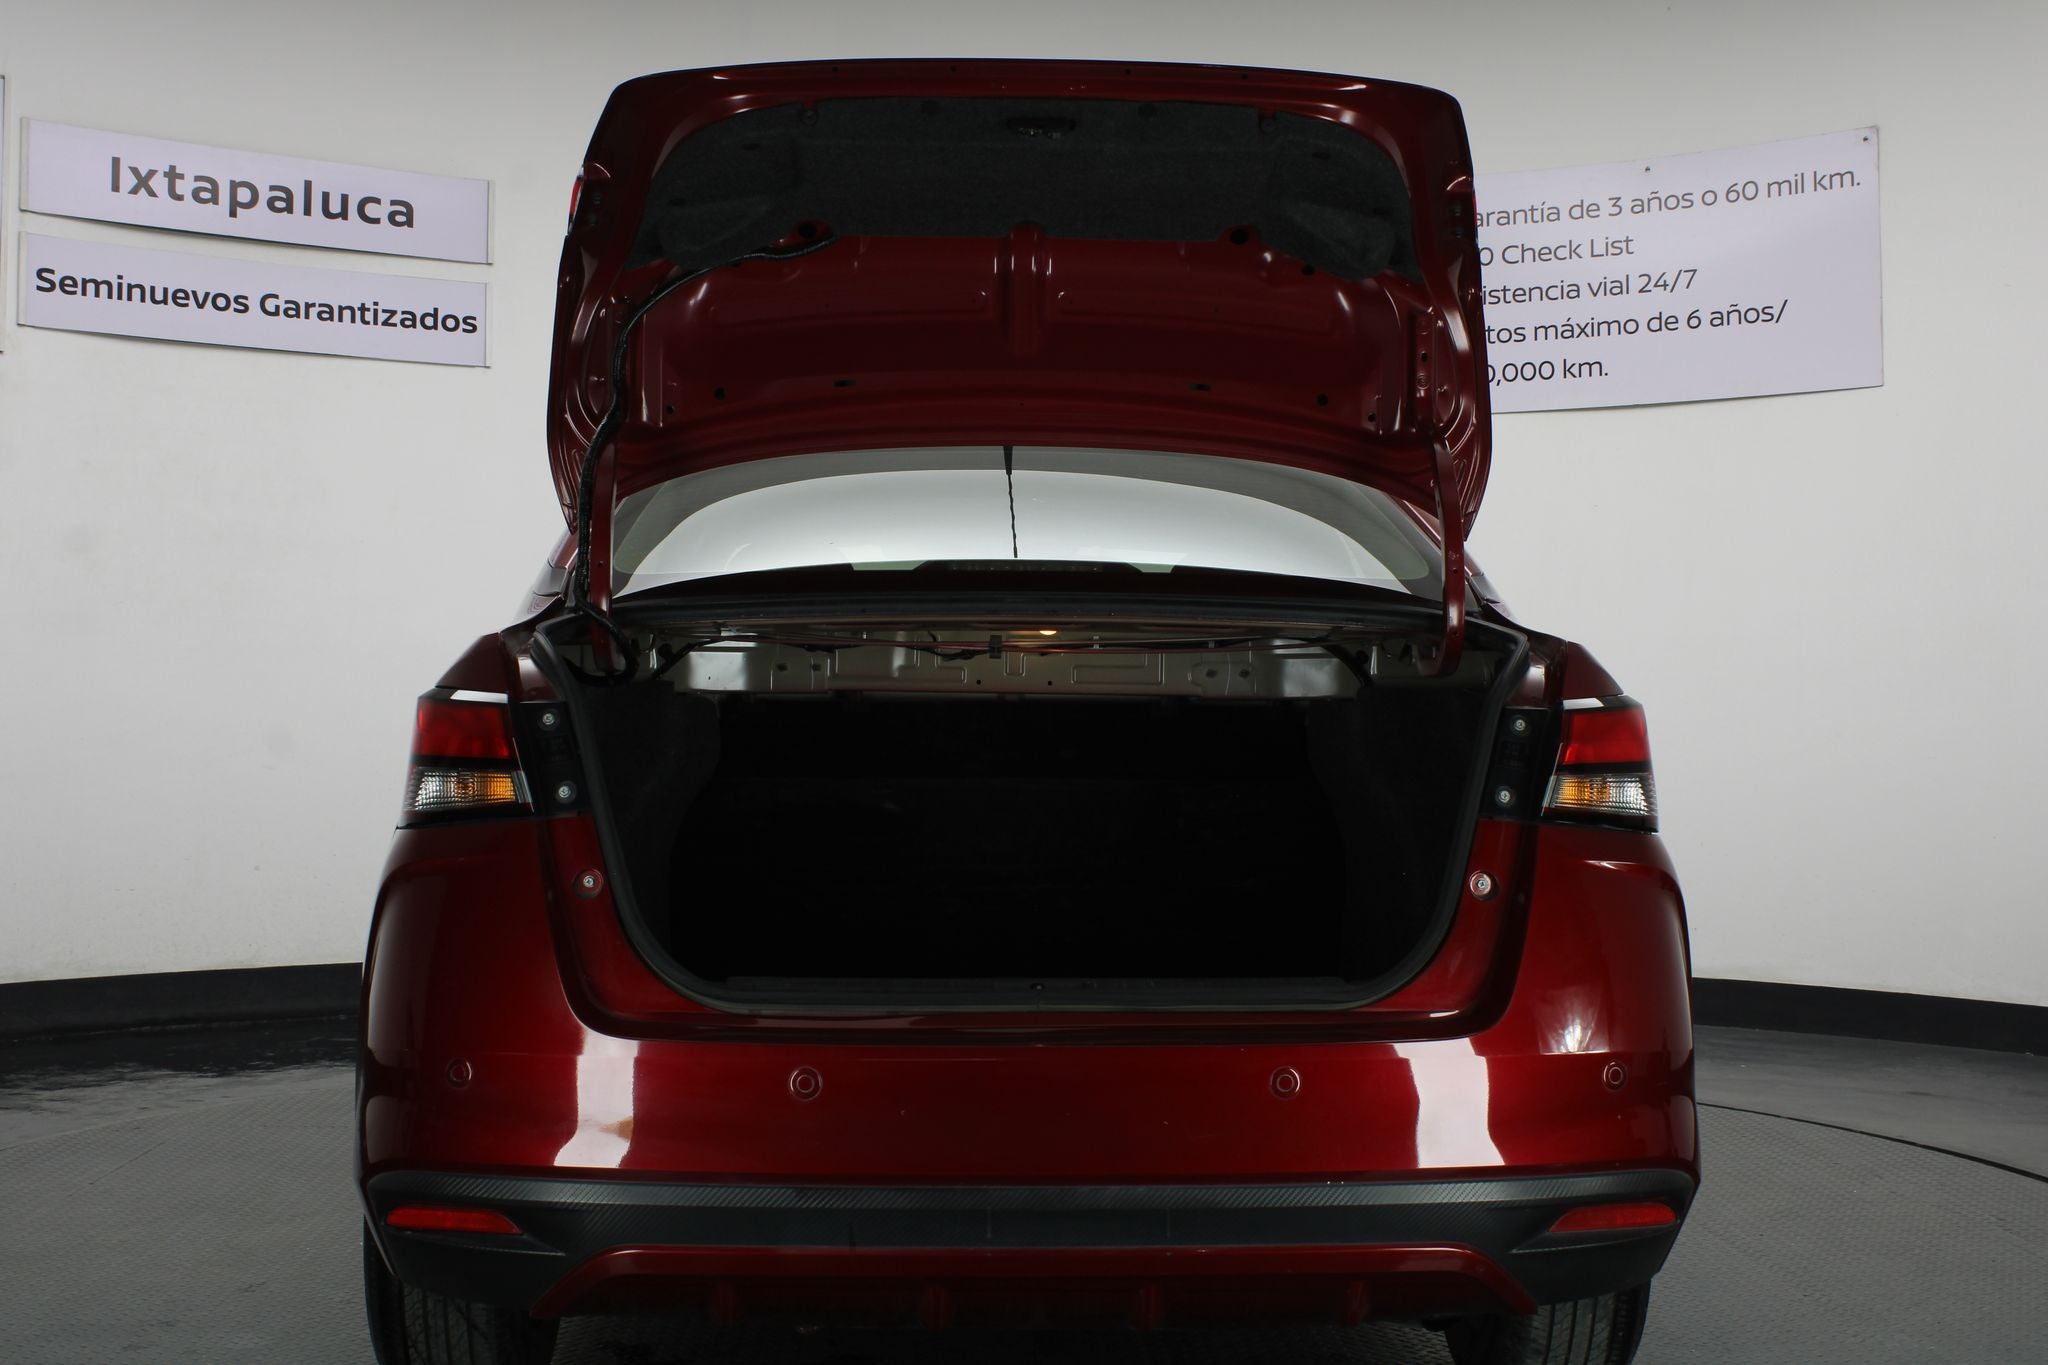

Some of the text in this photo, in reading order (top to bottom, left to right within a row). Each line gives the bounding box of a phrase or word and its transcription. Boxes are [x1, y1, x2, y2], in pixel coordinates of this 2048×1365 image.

[110, 156, 415, 228] Ixtapaluca
[1569, 199, 1600, 220] de
[1608, 197, 1622, 216] 3
[1631, 191, 1694, 214] años
[1702, 190, 1717, 206] o
[1726, 181, 1758, 203] 60
[1768, 173, 1804, 198] mil
[1814, 171, 1860, 192] km.
[1502, 240, 1583, 264] Check
[1591, 236, 1634, 257] List
[36, 268, 477, 334] Seminuevos Garantizados
[1483, 269, 1697, 305] istencia vial 24/7
[1486, 299, 1788, 344] tos máximo de 6 años/
[1563, 359, 1608, 379] km.
